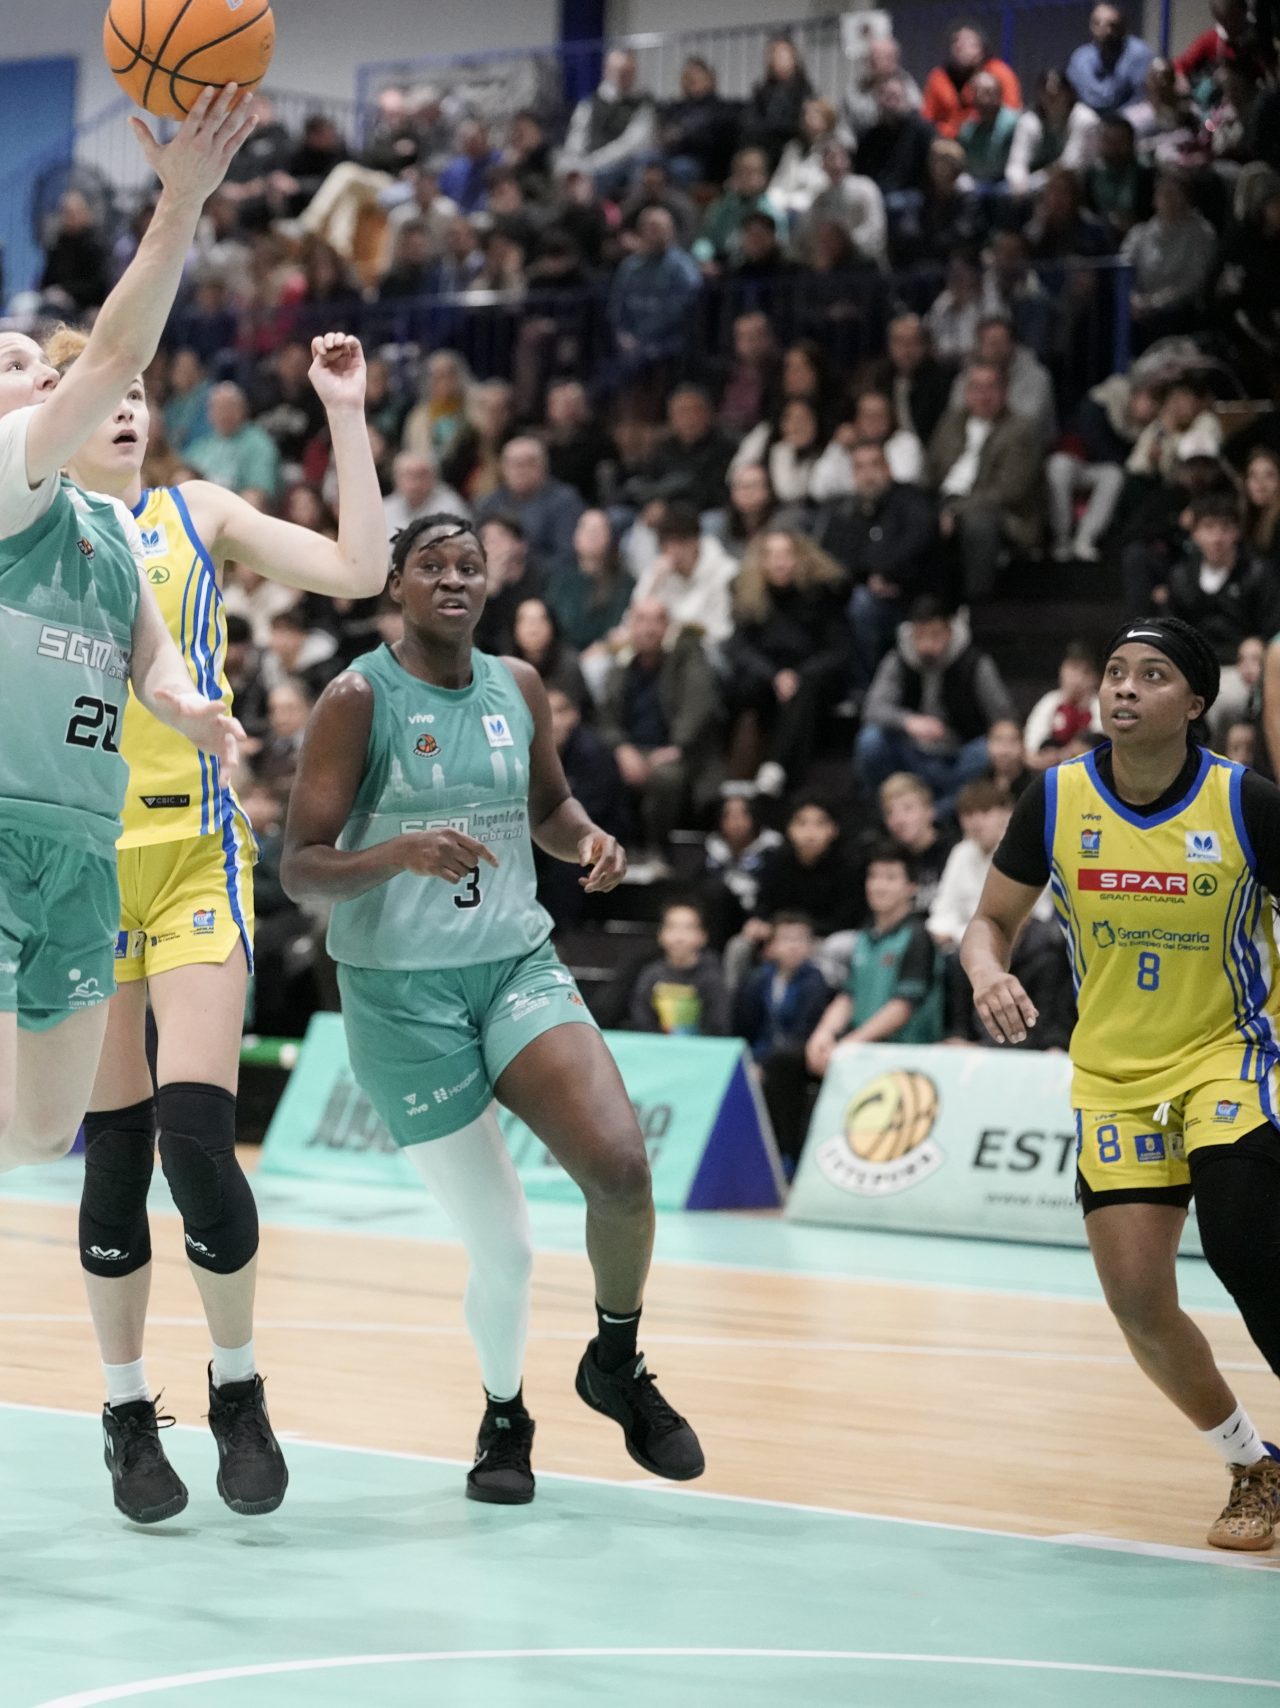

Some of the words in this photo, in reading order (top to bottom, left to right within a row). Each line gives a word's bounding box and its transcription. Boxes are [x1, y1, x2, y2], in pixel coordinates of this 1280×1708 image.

[37, 624, 113, 672] SGM
[407, 712, 436, 725] vive
[453, 865, 482, 910] 3
[1100, 872, 1186, 892] SPAR
[1100, 893, 1130, 902] GRAN
[1133, 894, 1186, 905] CANARIA
[1118, 927, 1150, 940] Gran
[1152, 928, 1210, 944] Canaria
[1137, 951, 1160, 991] 8
[972, 1127, 1077, 1175] EST
[1096, 1124, 1122, 1164] 8
